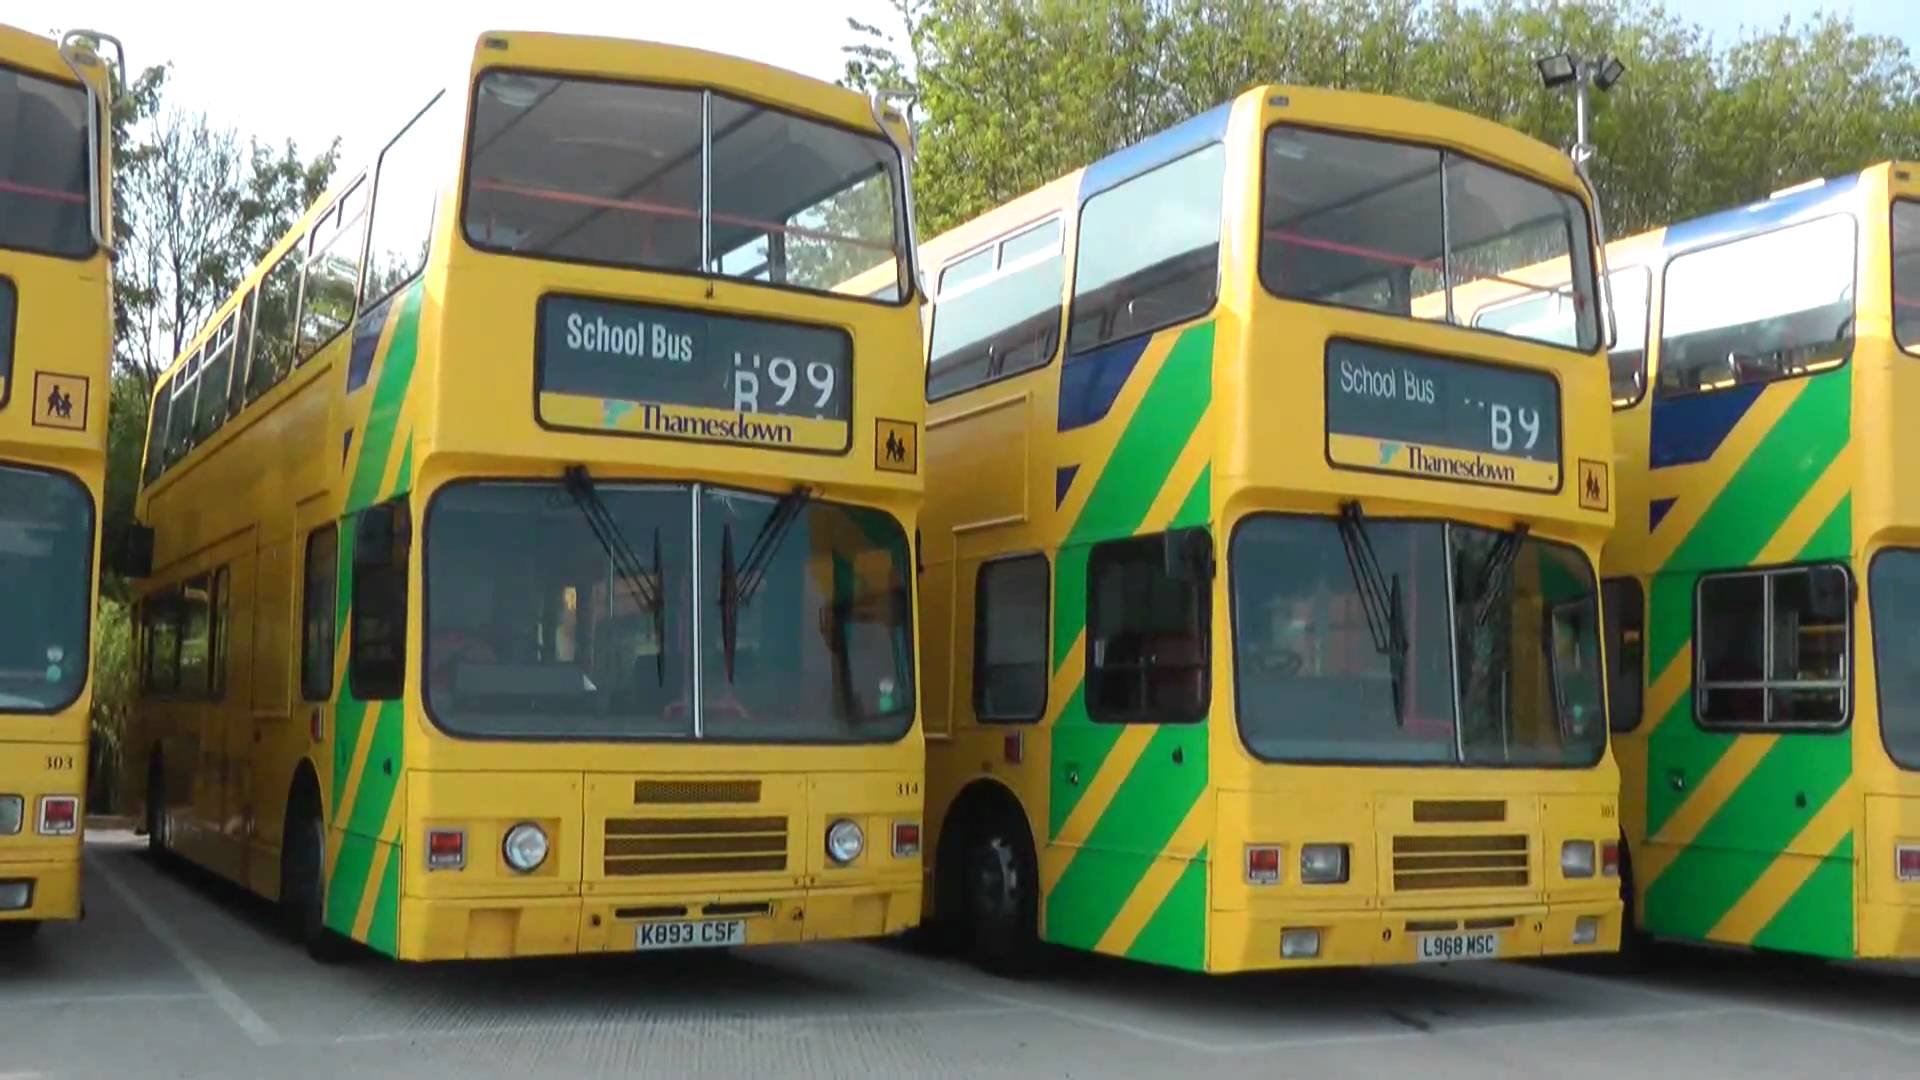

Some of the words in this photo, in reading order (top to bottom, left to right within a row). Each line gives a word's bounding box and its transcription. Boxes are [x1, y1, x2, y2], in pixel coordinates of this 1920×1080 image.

[566, 313, 643, 357] School
[651, 325, 692, 362] Bus
[1340, 361, 1396, 398] School
[1404, 370, 1435, 404] Bus
[640, 403, 791, 442] Thamesdown
[1490, 404, 1539, 451] B9
[1406, 446, 1515, 482] Thamesdown
[641, 924, 694, 945] K893
[701, 922, 739, 942] CSF
[1423, 936, 1463, 957] L968
